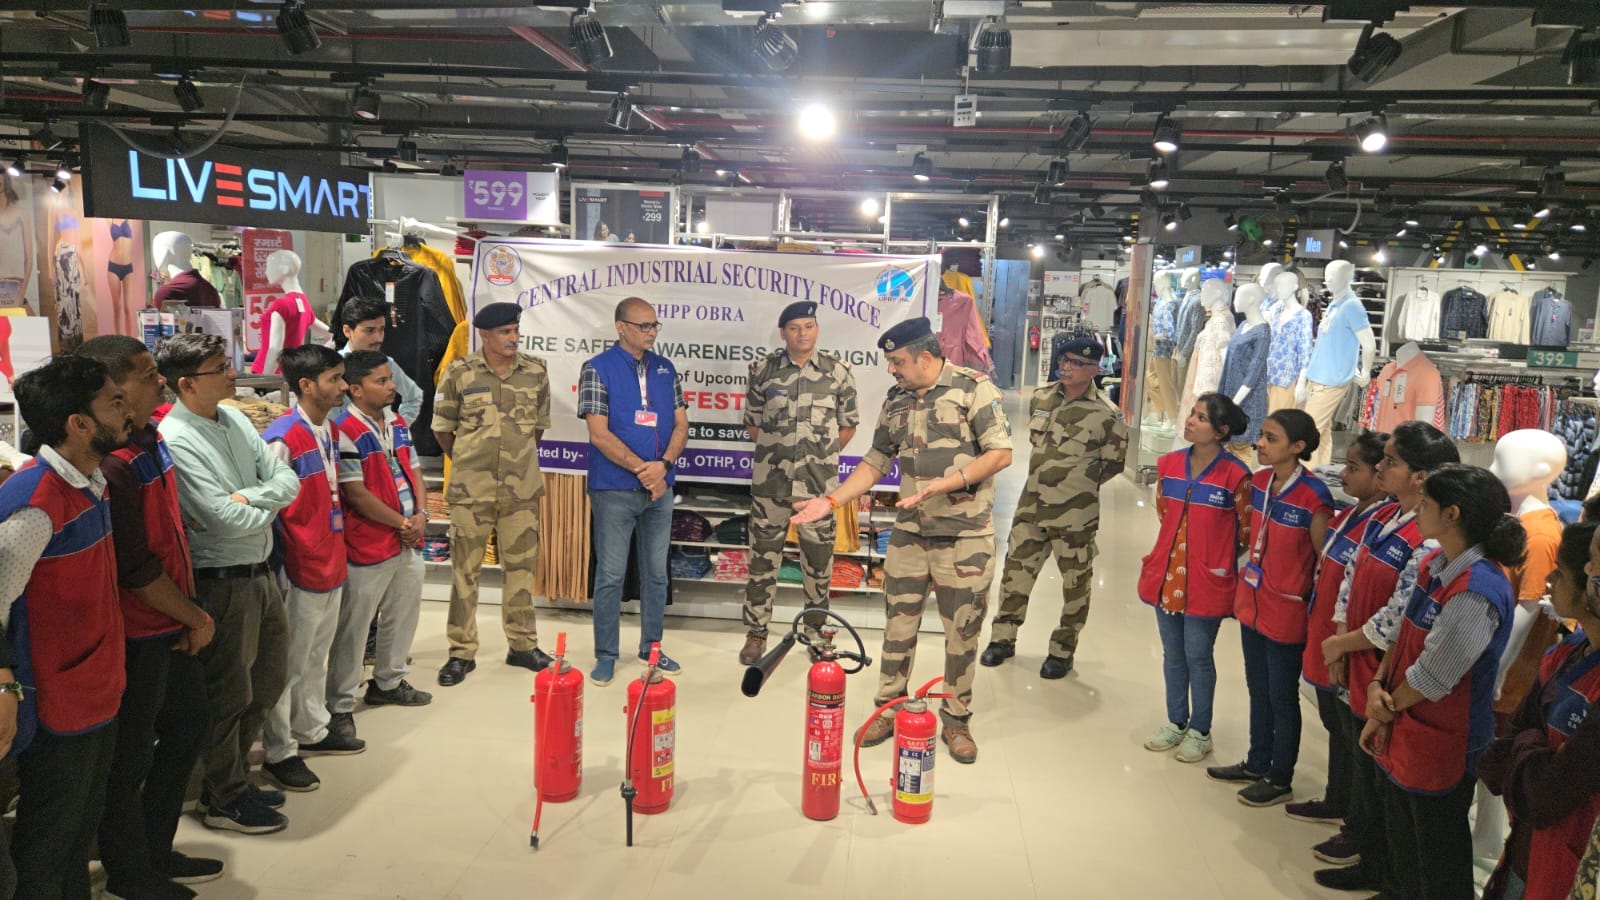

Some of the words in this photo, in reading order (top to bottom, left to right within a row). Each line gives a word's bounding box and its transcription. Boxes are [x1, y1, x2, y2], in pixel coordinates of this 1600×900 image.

[129, 150, 370, 218] LIVESMART
[1305, 236, 1322, 253] Men
[515, 268, 601, 309] CENTRAL
[608, 260, 717, 288] INDUSTRIAL
[722, 262, 815, 300] SECURITY
[819, 283, 881, 329] FORCE
[652, 303, 692, 320] HPP
[695, 304, 745, 322] OBRA
[564, 337, 614, 354] SAFE
[677, 370, 691, 383] of
[694, 371, 748, 387] Upcom
[683, 391, 746, 411] FEST
[700, 426, 714, 438] to
[562, 447, 584, 463] by-
[694, 455, 736, 471] OTHP,
[811, 772, 838, 786] FIR
